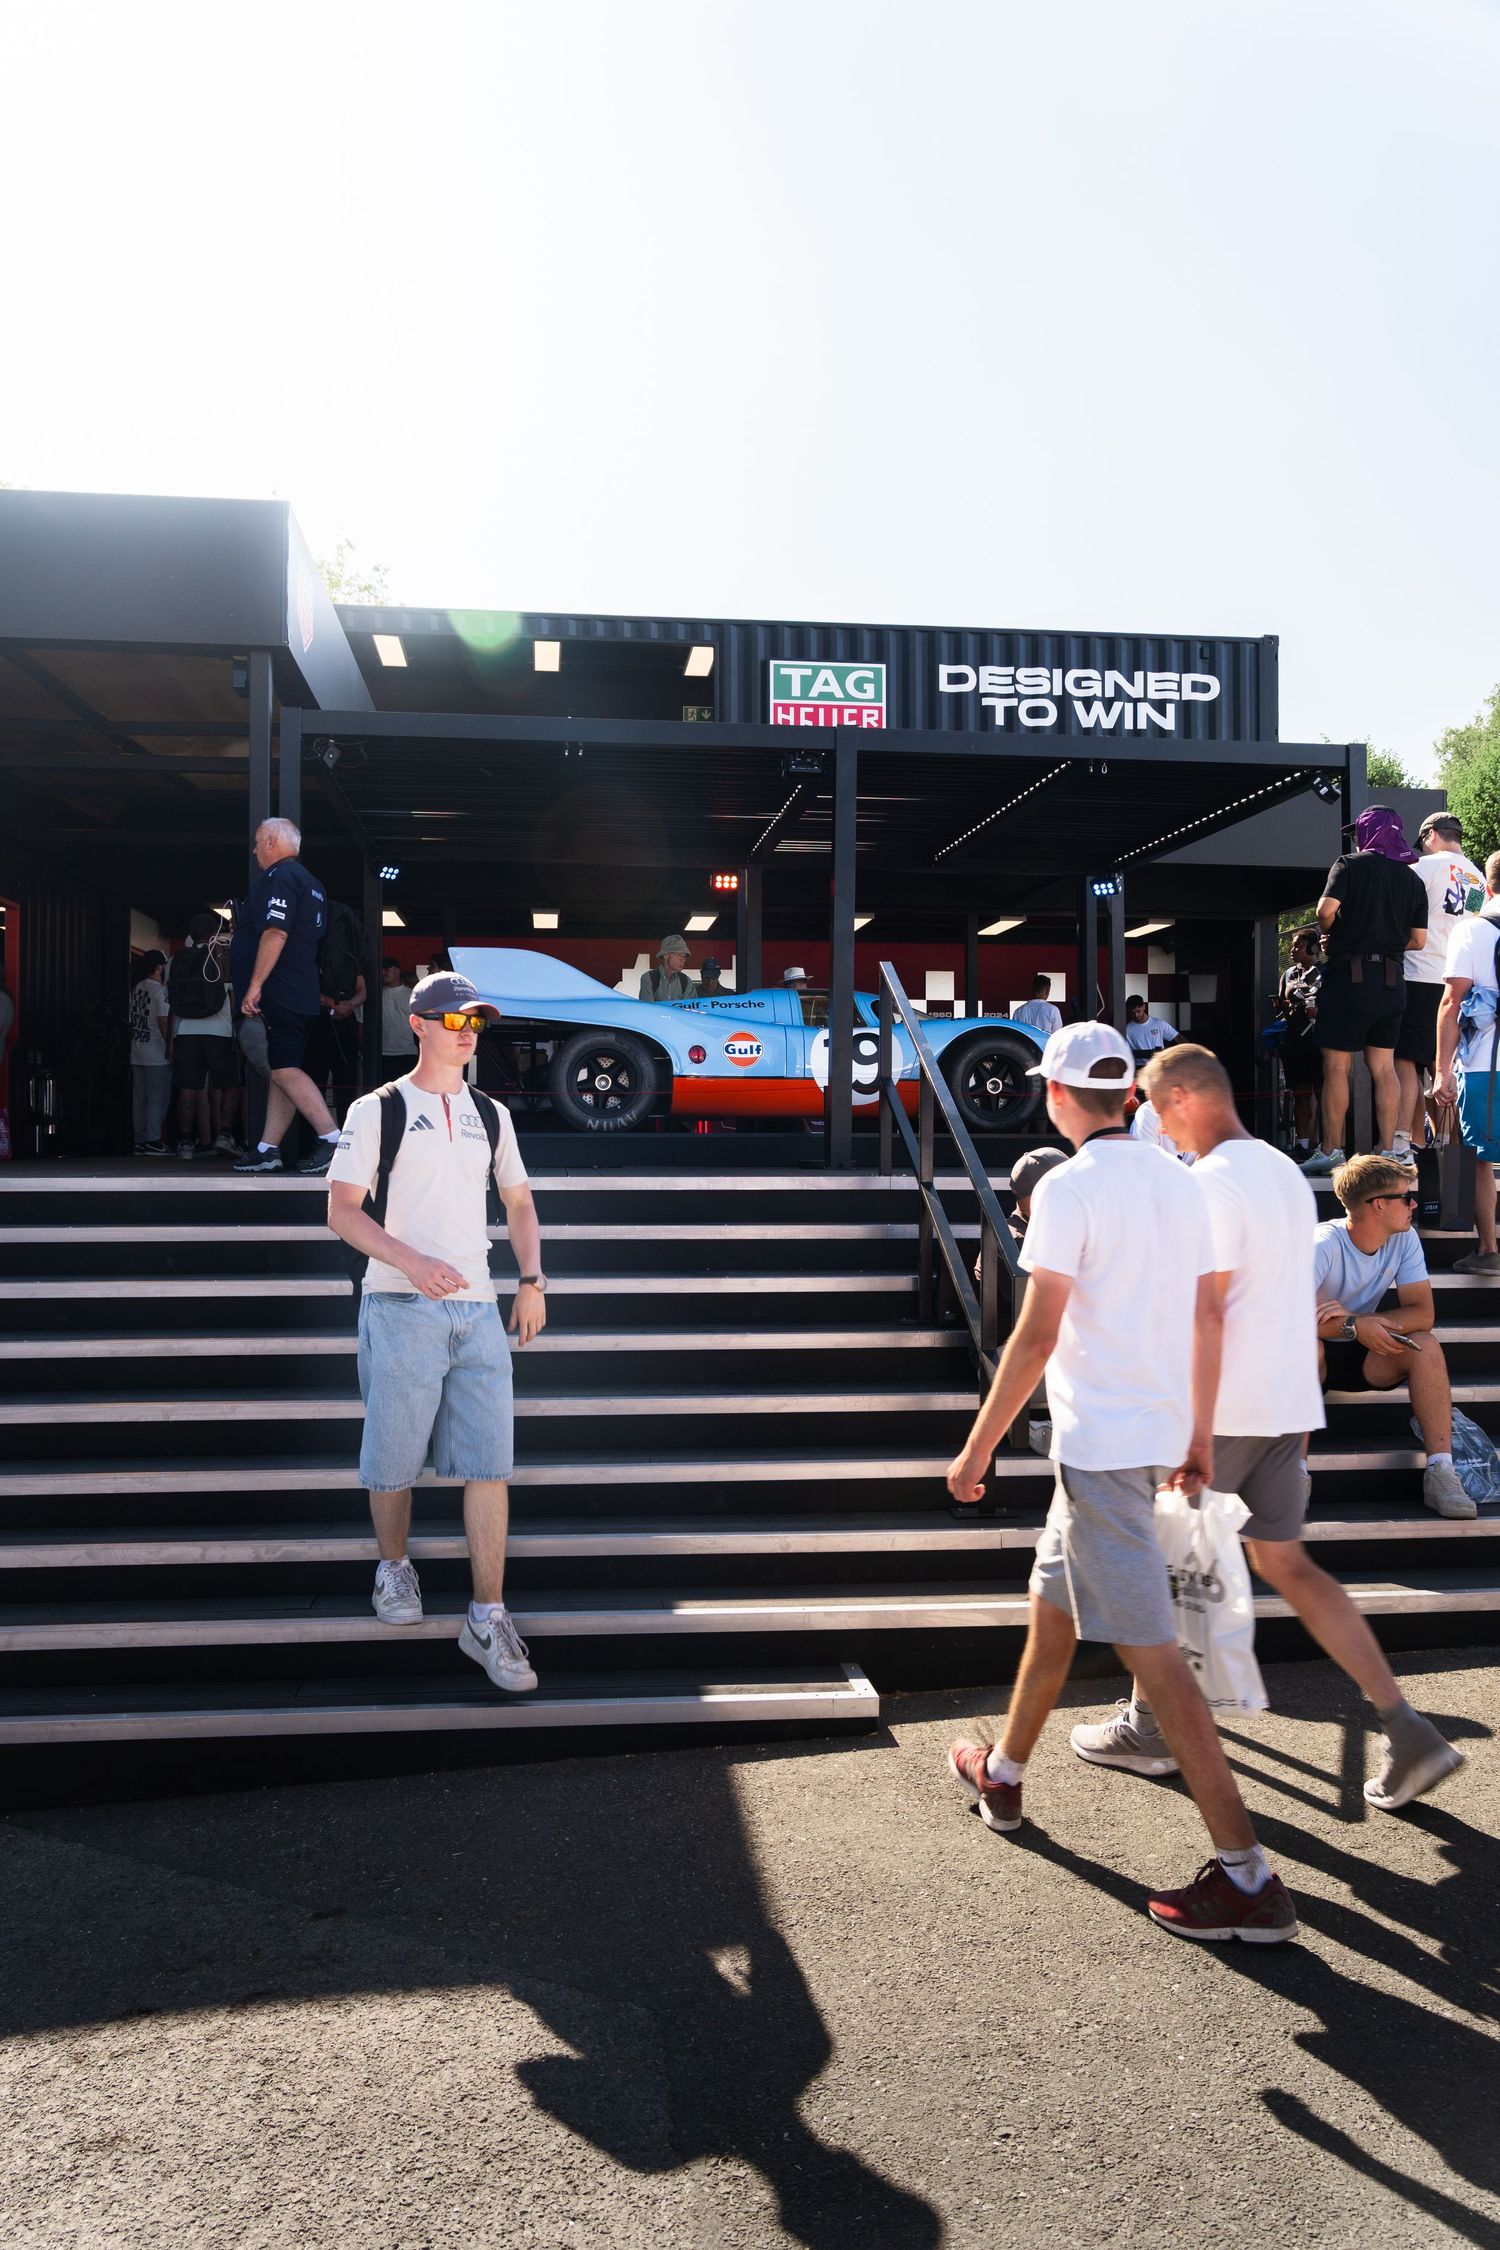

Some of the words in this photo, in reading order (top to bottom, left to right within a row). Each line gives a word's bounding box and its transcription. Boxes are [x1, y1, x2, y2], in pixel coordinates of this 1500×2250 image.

[779, 667, 876, 700] TAG
[938, 664, 1221, 702] DESIGNED
[777, 706, 879, 728] HEUER
[981, 697, 1058, 727] TO
[1072, 700, 1176, 731] WIN
[671, 1001, 701, 1010] Gulf
[710, 999, 766, 1010] Porsche
[724, 1043, 762, 1055] Gulf
